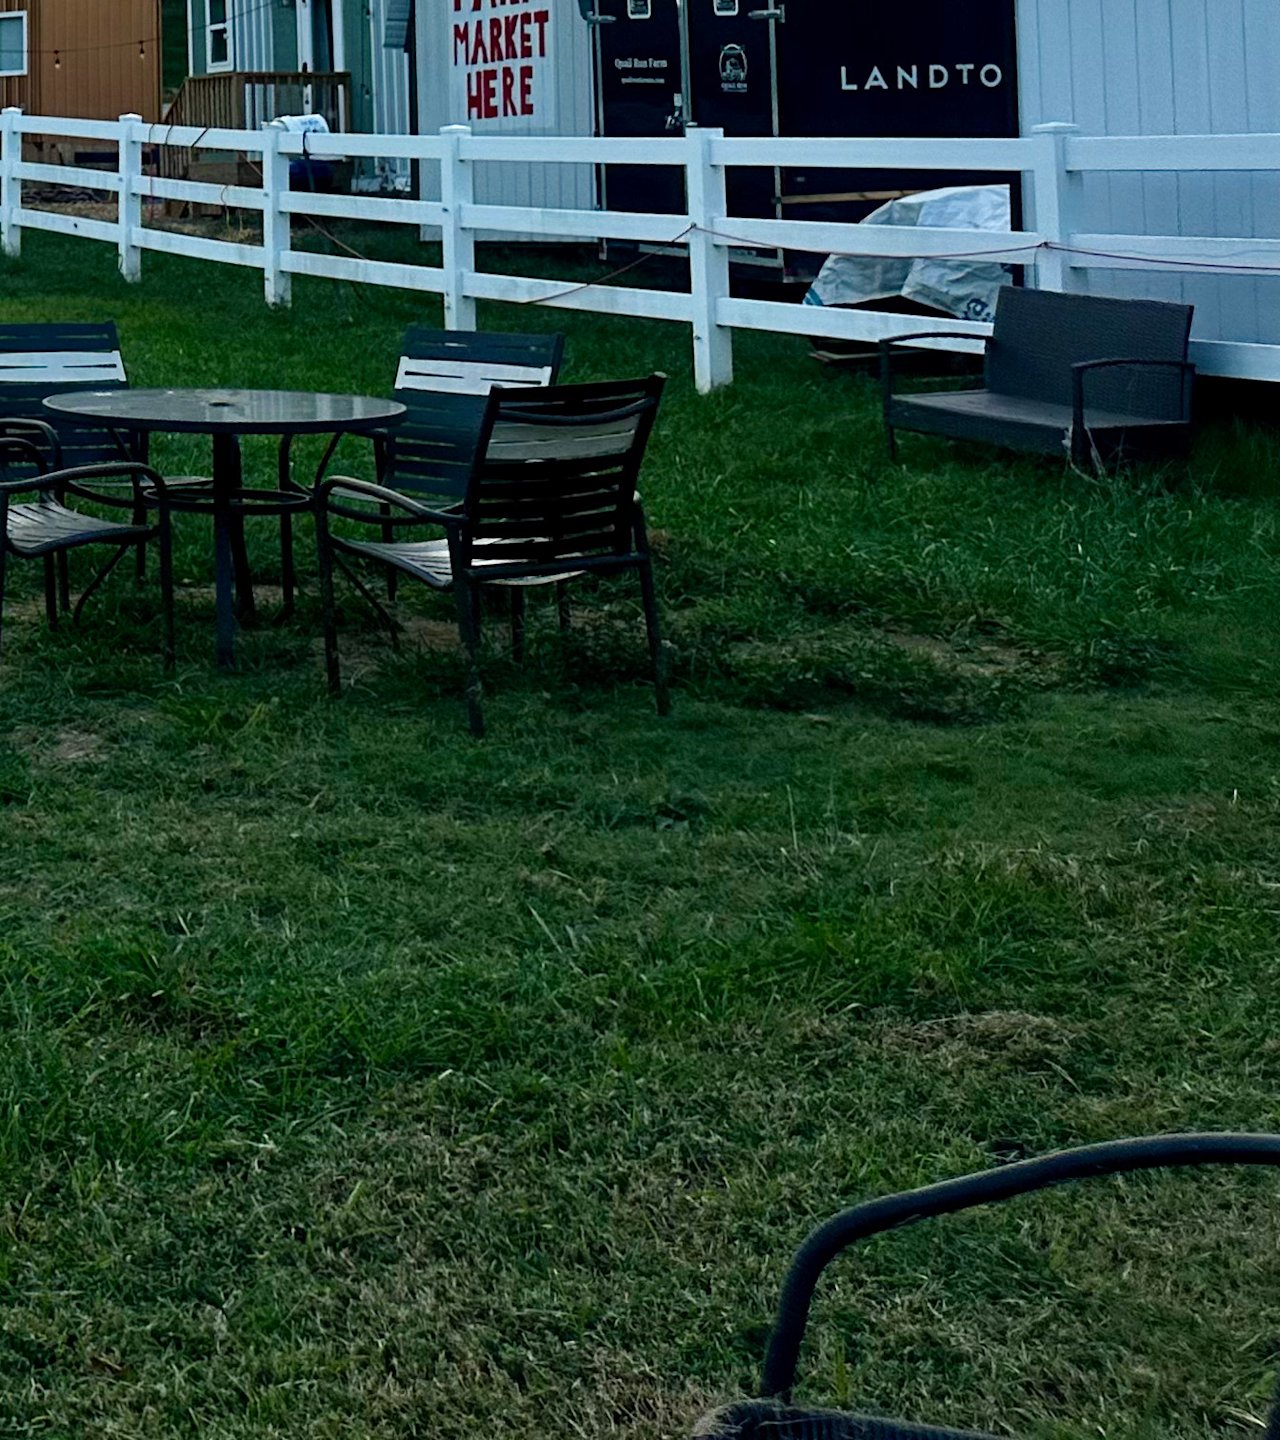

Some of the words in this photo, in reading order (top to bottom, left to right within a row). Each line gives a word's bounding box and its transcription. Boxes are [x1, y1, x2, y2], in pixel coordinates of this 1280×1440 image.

[453, 10, 549, 66] MARKET
[467, 66, 534, 120] HERE
[840, 63, 1003, 91] LANDTO
